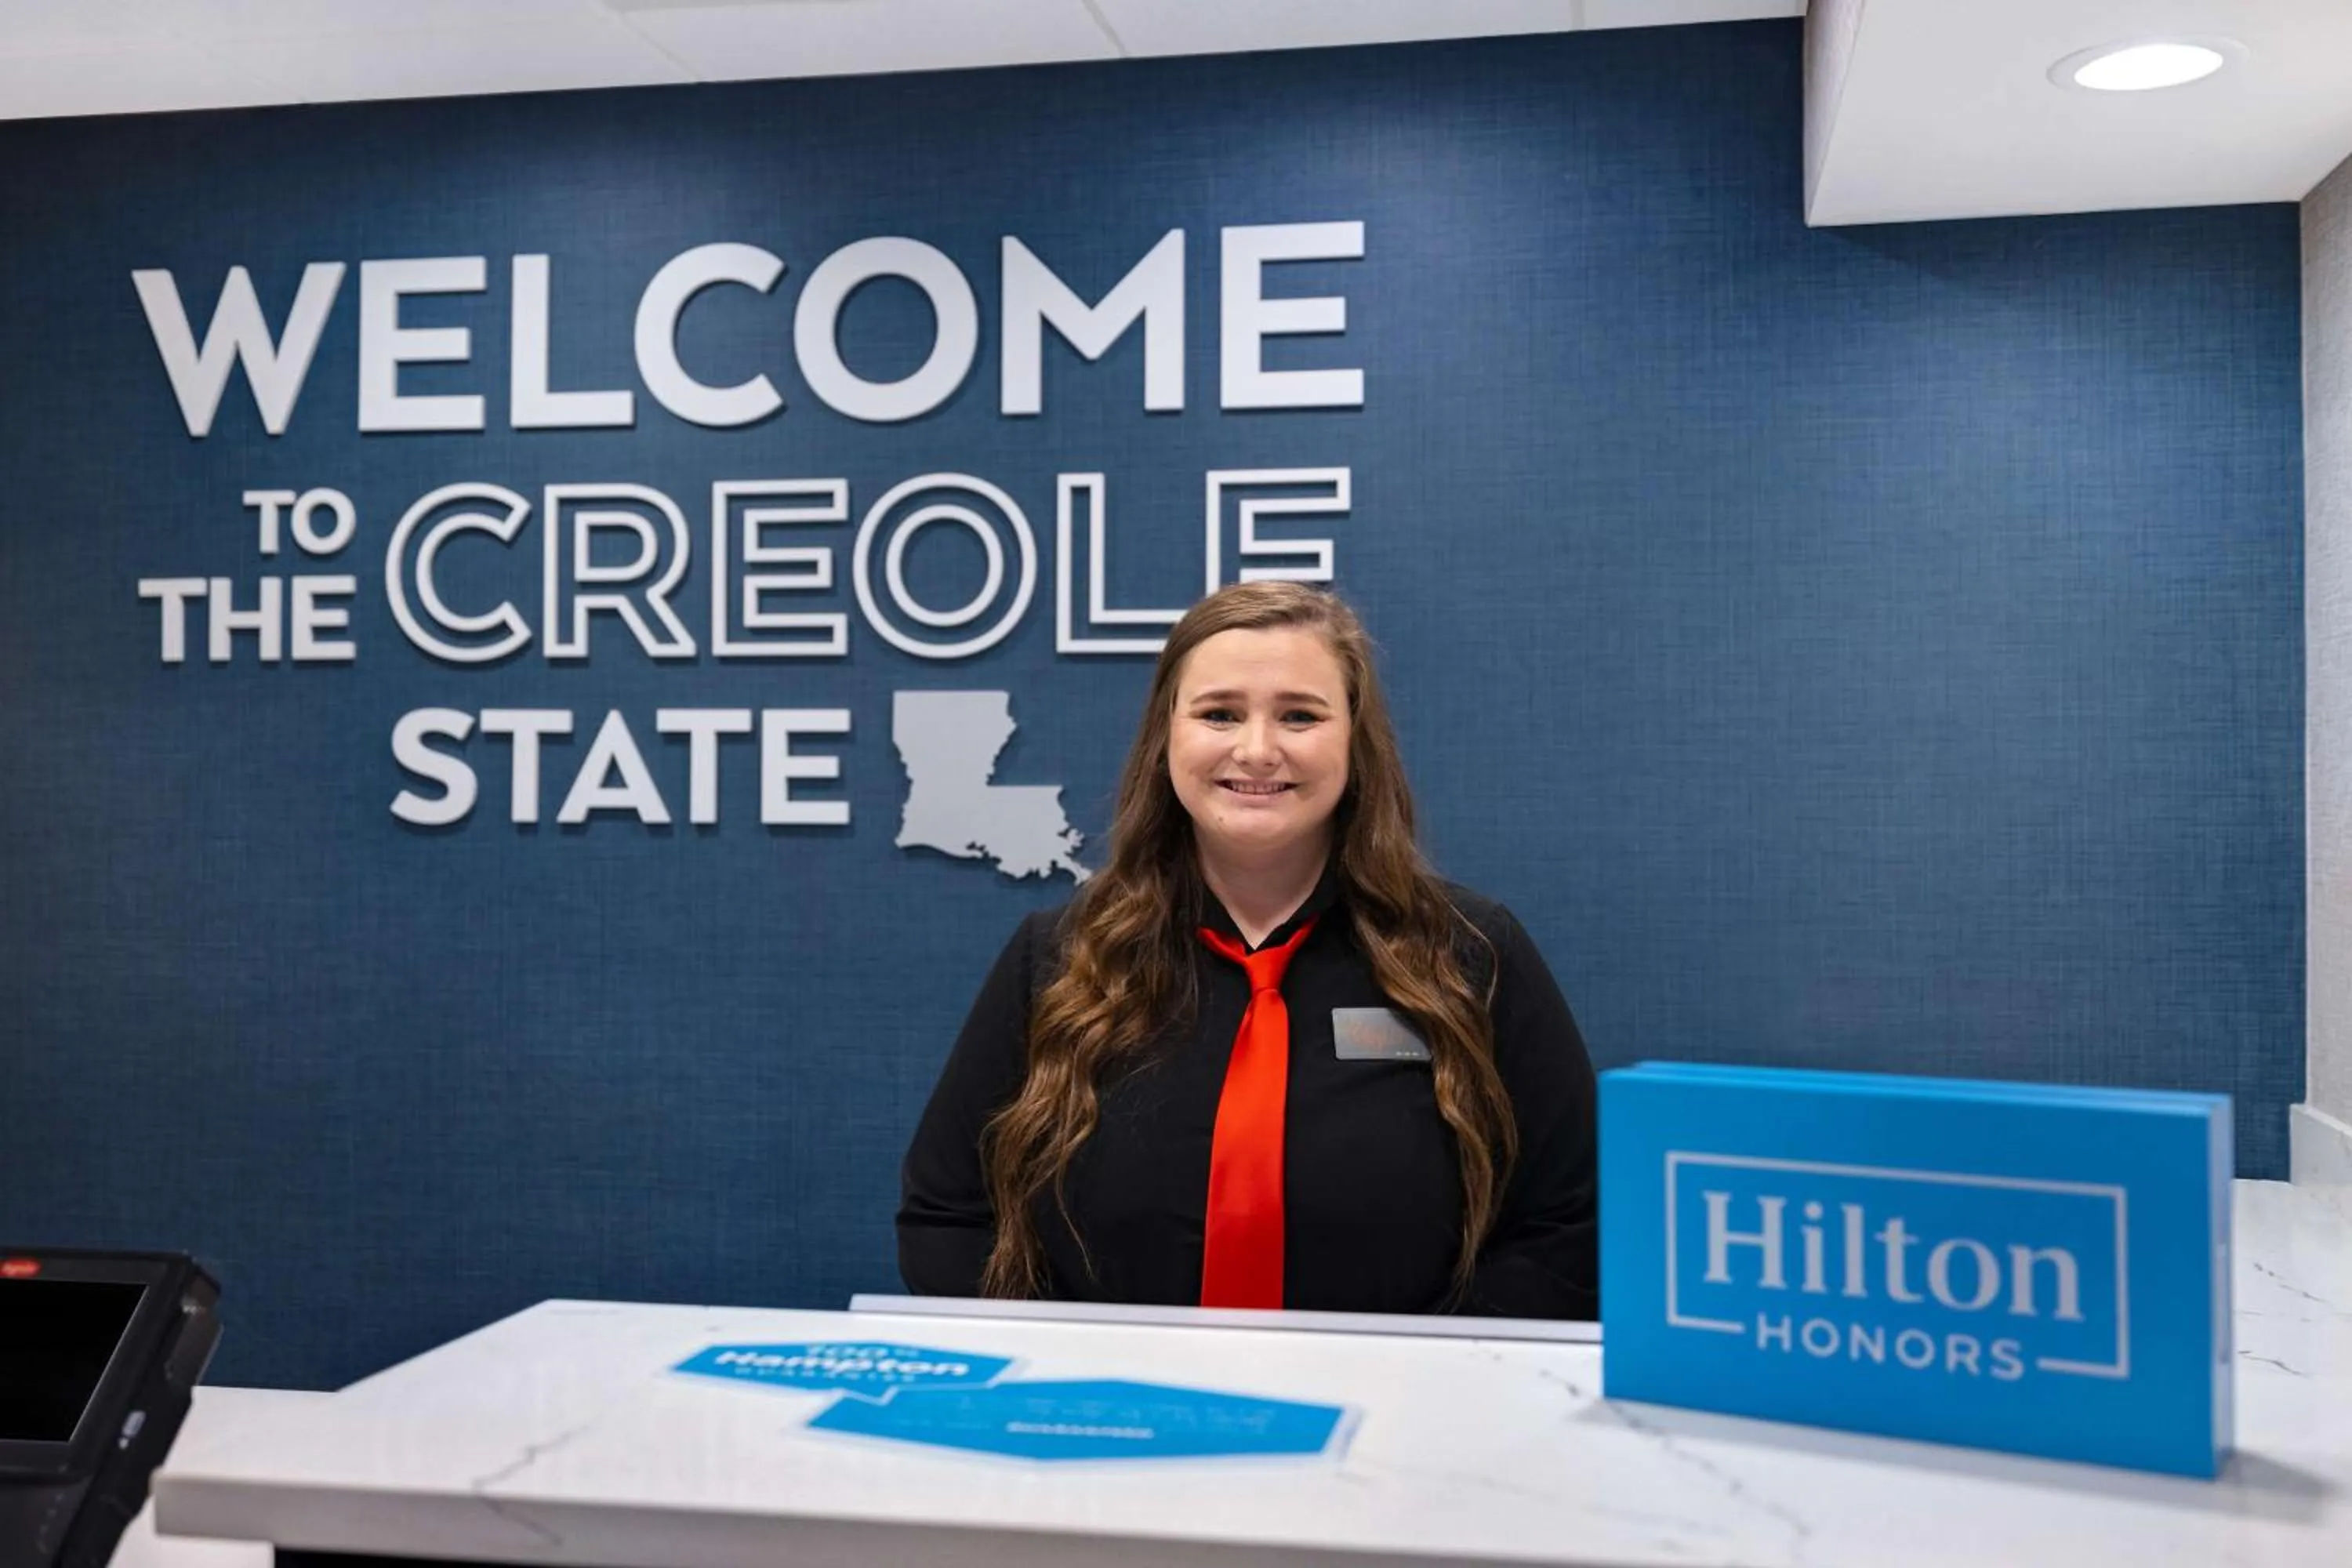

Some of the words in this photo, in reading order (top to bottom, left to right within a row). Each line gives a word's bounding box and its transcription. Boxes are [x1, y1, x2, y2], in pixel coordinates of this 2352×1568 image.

[131, 220, 1366, 437] WELCOME
[243, 487, 356, 554] TO
[384, 467, 1352, 662] CREOLE
[138, 574, 357, 662] THE
[390, 707, 851, 826] STATE
[1702, 1189, 2085, 1322] Hilton
[714, 1349, 971, 1377] Hampton
[1756, 1312, 2026, 1382] HONORS
